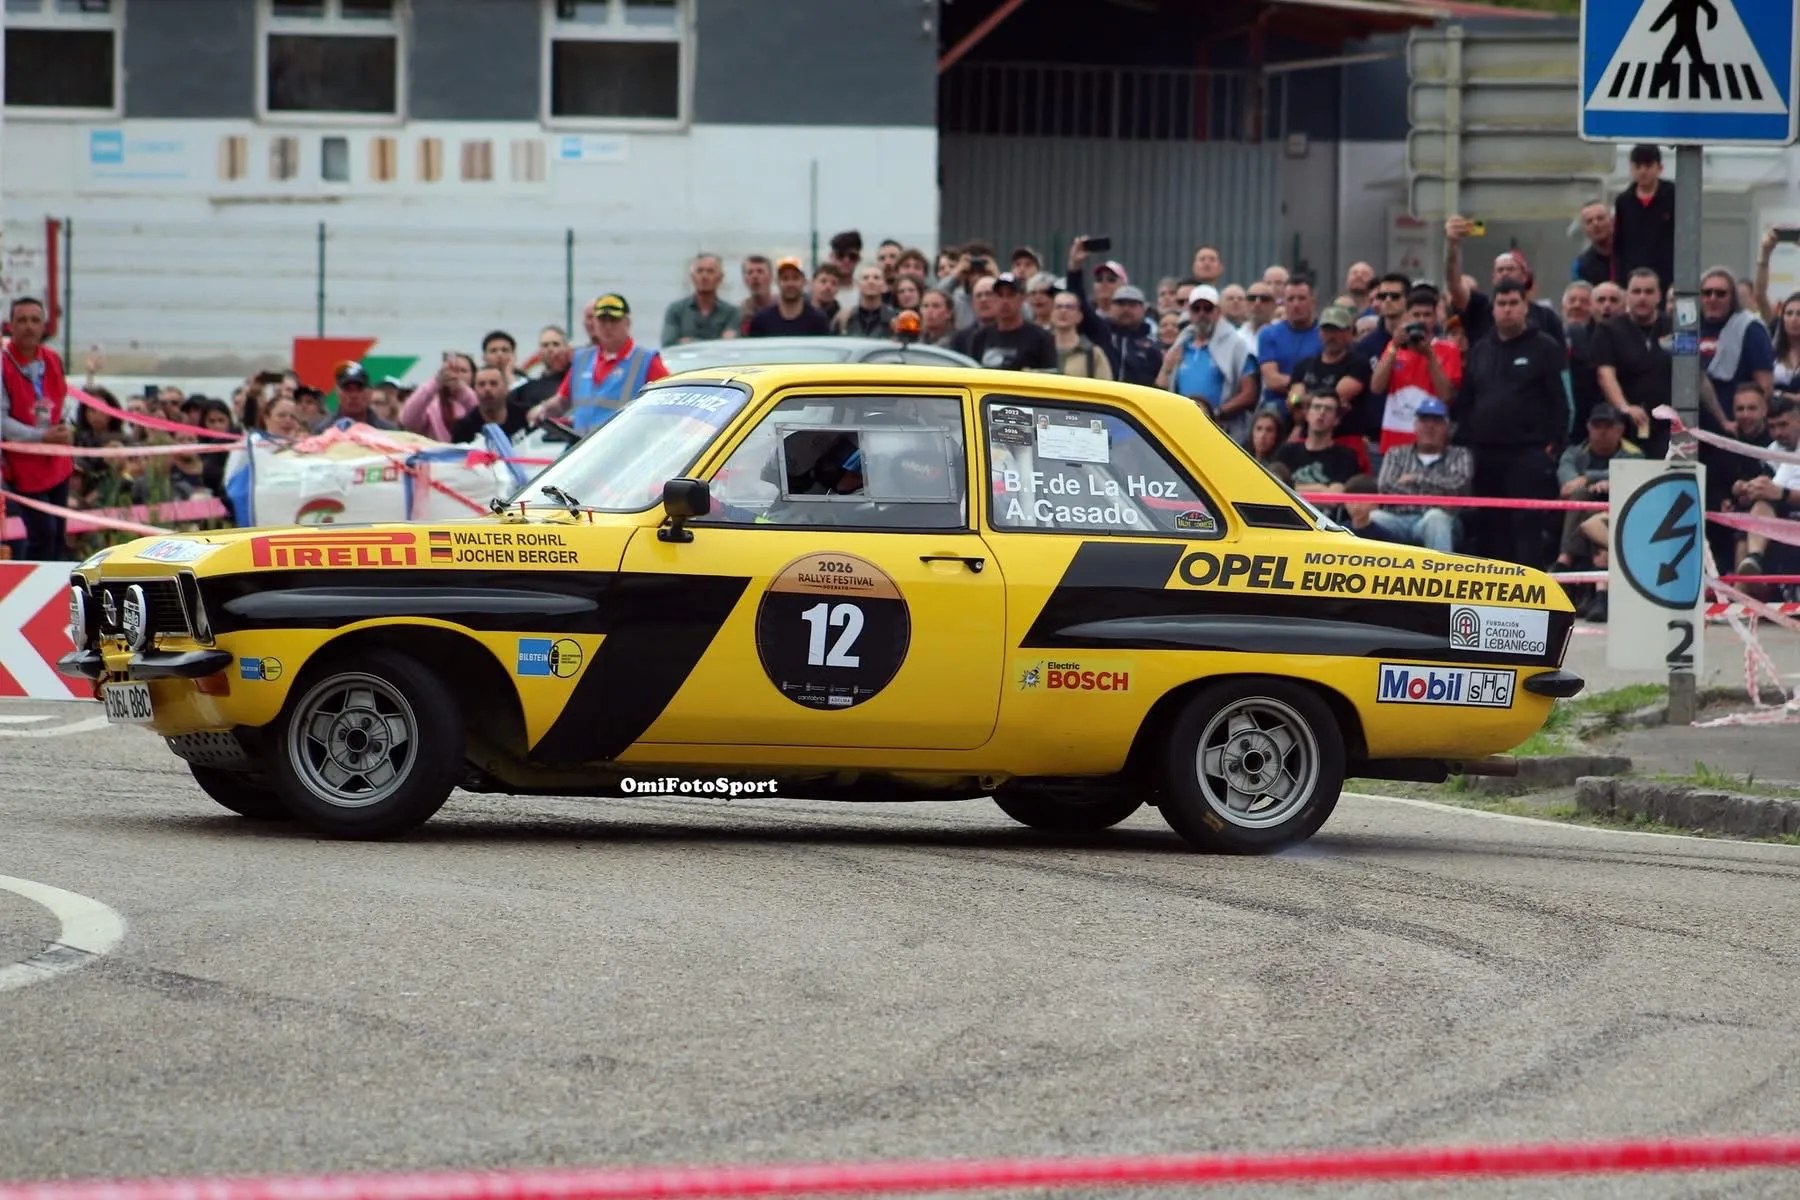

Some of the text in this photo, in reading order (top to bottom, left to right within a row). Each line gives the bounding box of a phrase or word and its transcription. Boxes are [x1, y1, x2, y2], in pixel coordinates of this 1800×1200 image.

[1004, 470, 1179, 498] B.F.de La Hoz
[1005, 498, 1138, 525] A.Casado
[250, 532, 417, 567] PIRELLI
[454, 532, 567, 547] WALTER ROHRL
[456, 549, 579, 564] JOCHEN BERGER
[818, 561, 853, 573] 2026
[1304, 553, 1526, 577] MOTOROLA Sprechfunk
[798, 573, 875, 587] RALLYE FESTIVAL
[1179, 552, 1294, 590] OPEL
[1301, 571, 1546, 605] EURO HANDLERTEAM
[801, 602, 865, 668] 12
[1485, 627, 1526, 639] CAMINO
[1666, 619, 1694, 663] 2
[519, 652, 548, 662] BILSTEIN
[1484, 638, 1545, 653] LEBANIEGO
[1047, 661, 1080, 670] Electric
[1047, 671, 1129, 690] BOSCH
[1382, 670, 1462, 701] Mobil
[129, 686, 151, 718] BBC
